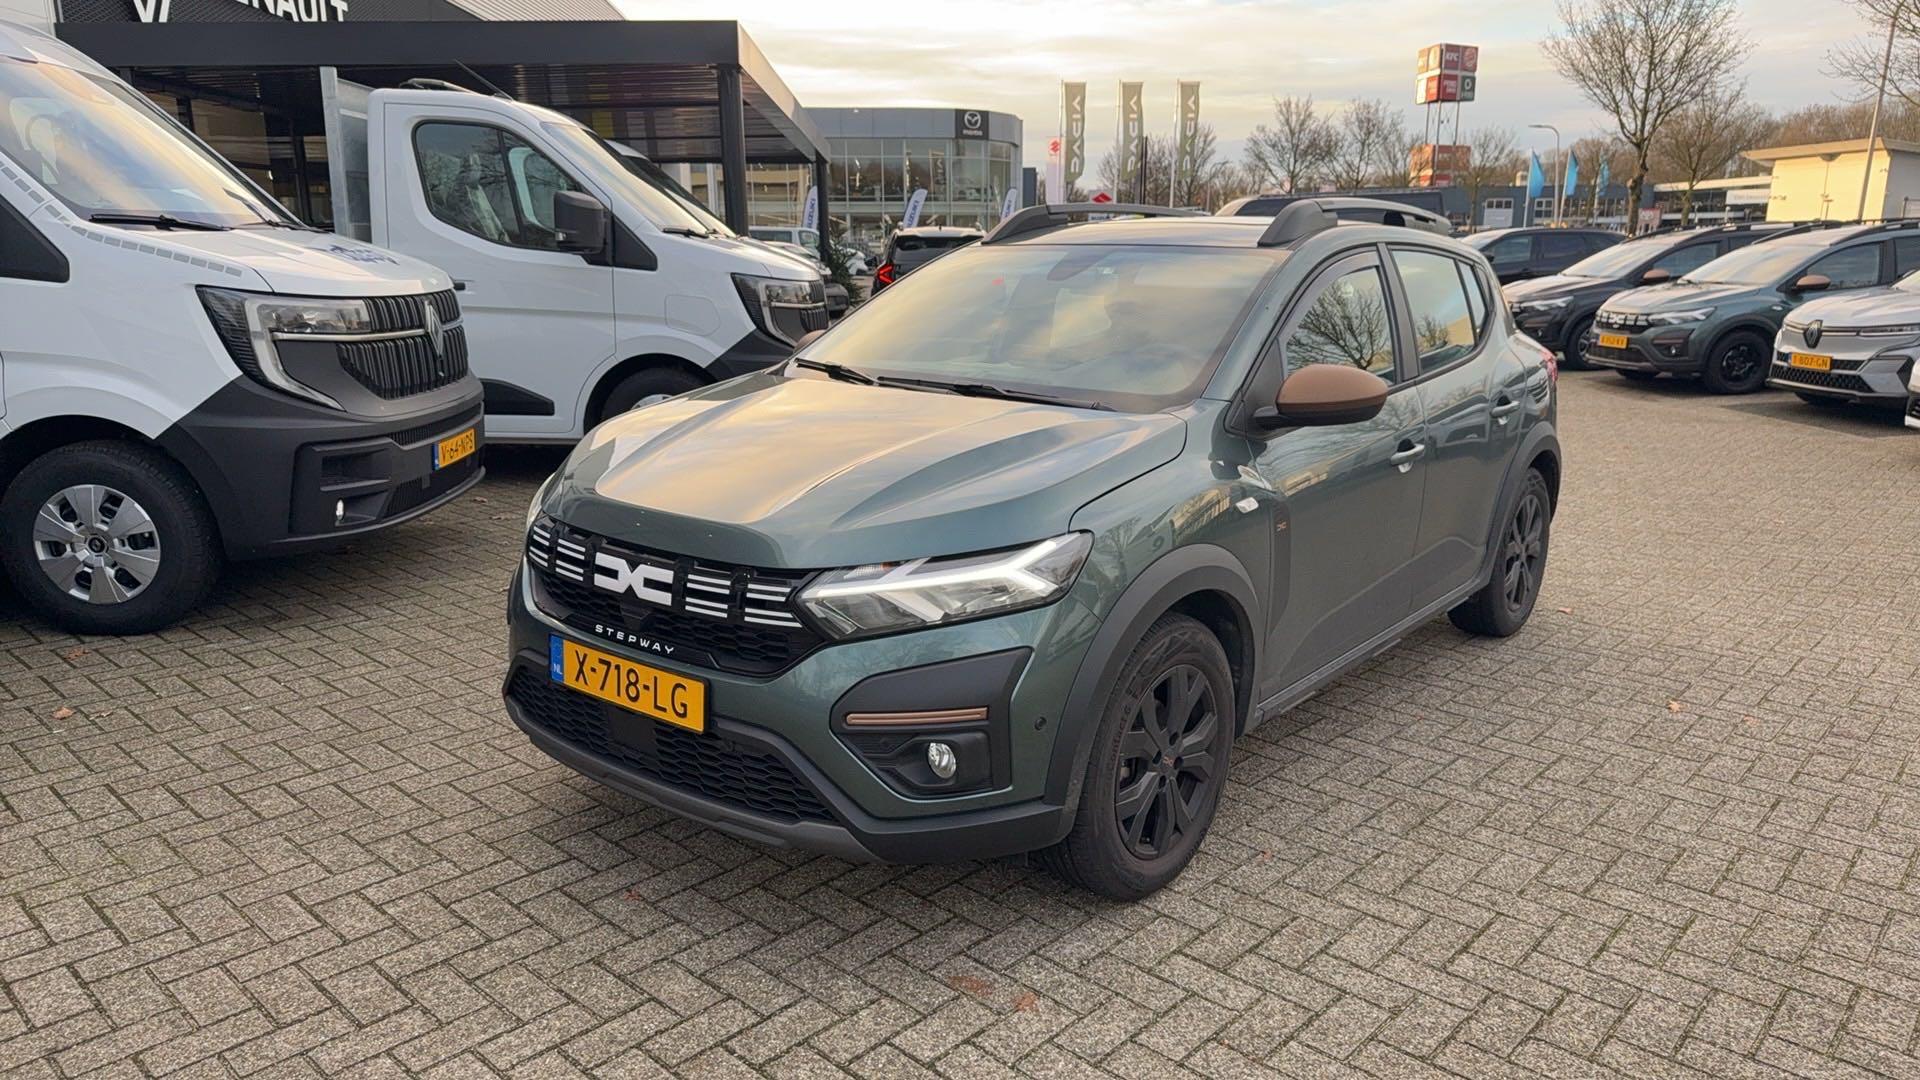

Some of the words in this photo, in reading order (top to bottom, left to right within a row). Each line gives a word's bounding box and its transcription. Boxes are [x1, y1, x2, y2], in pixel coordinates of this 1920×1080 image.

[595, 624, 674, 654] STEPWAY
[553, 663, 563, 675] NL
[575, 650, 688, 719] X-718-LG
